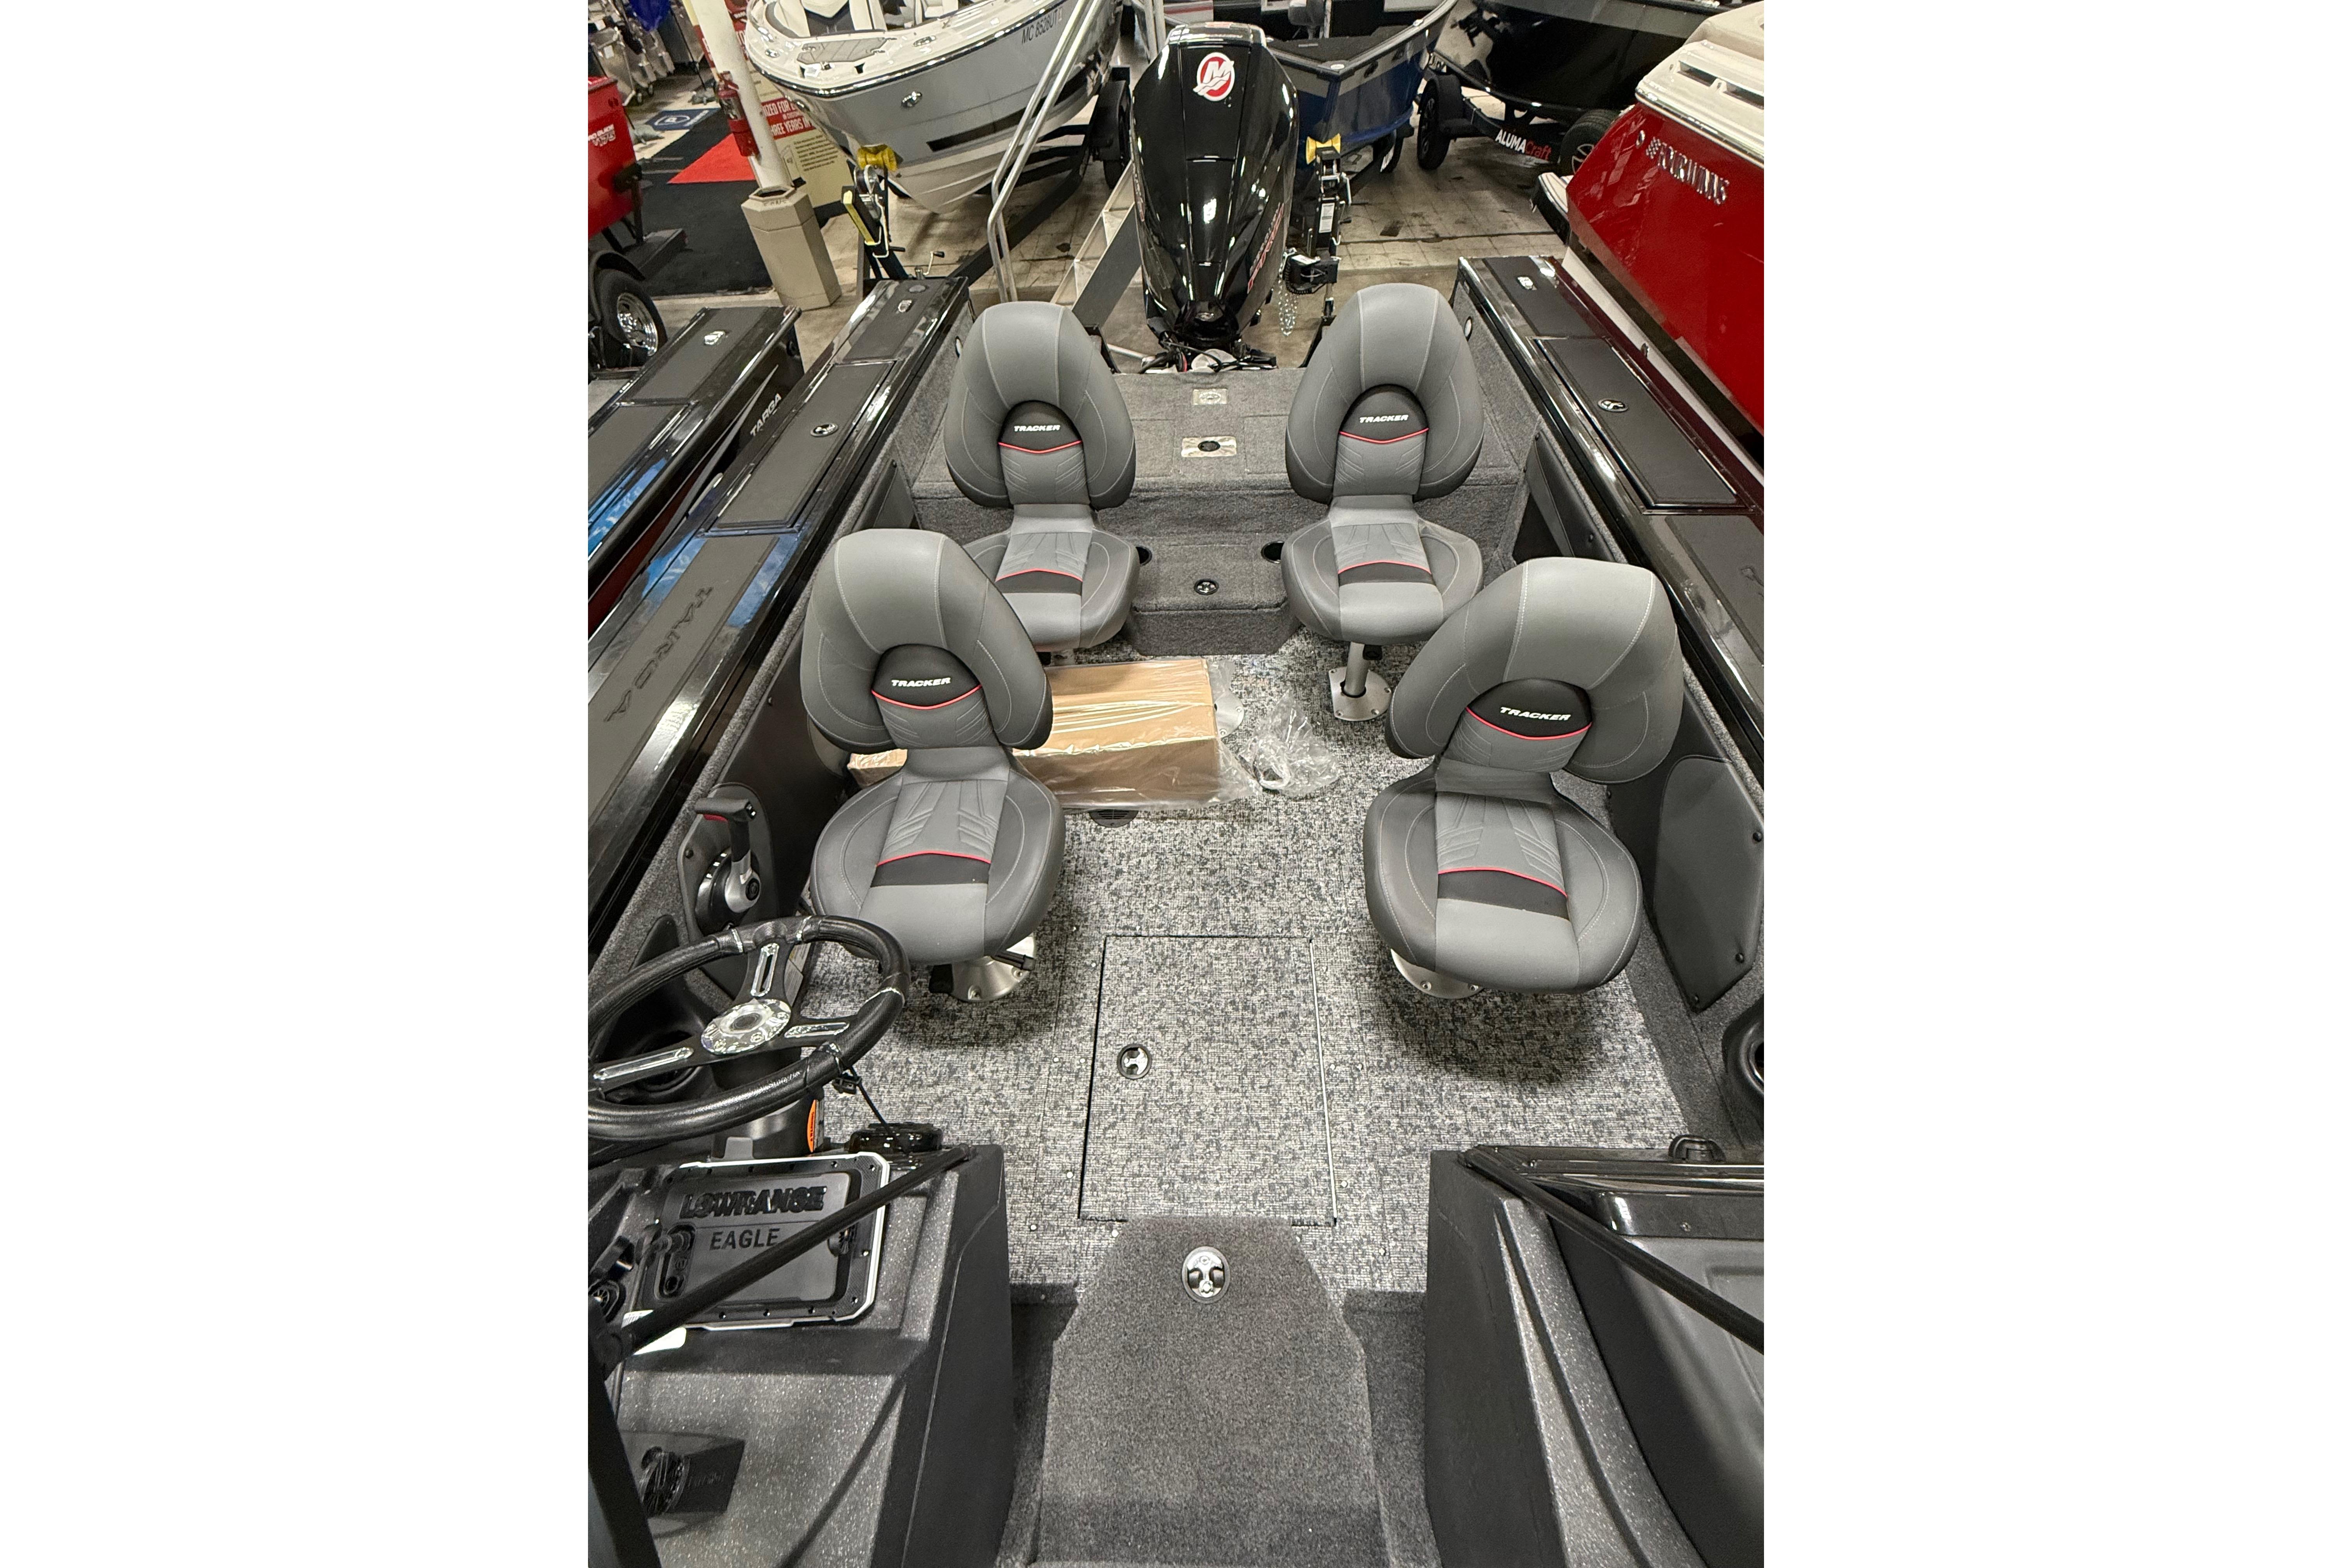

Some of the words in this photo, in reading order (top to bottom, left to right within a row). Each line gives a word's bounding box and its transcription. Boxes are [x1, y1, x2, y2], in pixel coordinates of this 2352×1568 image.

[777, 100, 791, 114] FOR
[784, 118, 804, 133] YEARS
[750, 393, 782, 437] TARGA
[1360, 414, 1409, 423] TRACKER
[603, 586, 714, 722] TARGA
[891, 677, 951, 687] TRACKER
[1500, 706, 1572, 721] TRACKER
[679, 1186, 828, 1219] LOWRANCE
[709, 1228, 780, 1251] EAGLE
